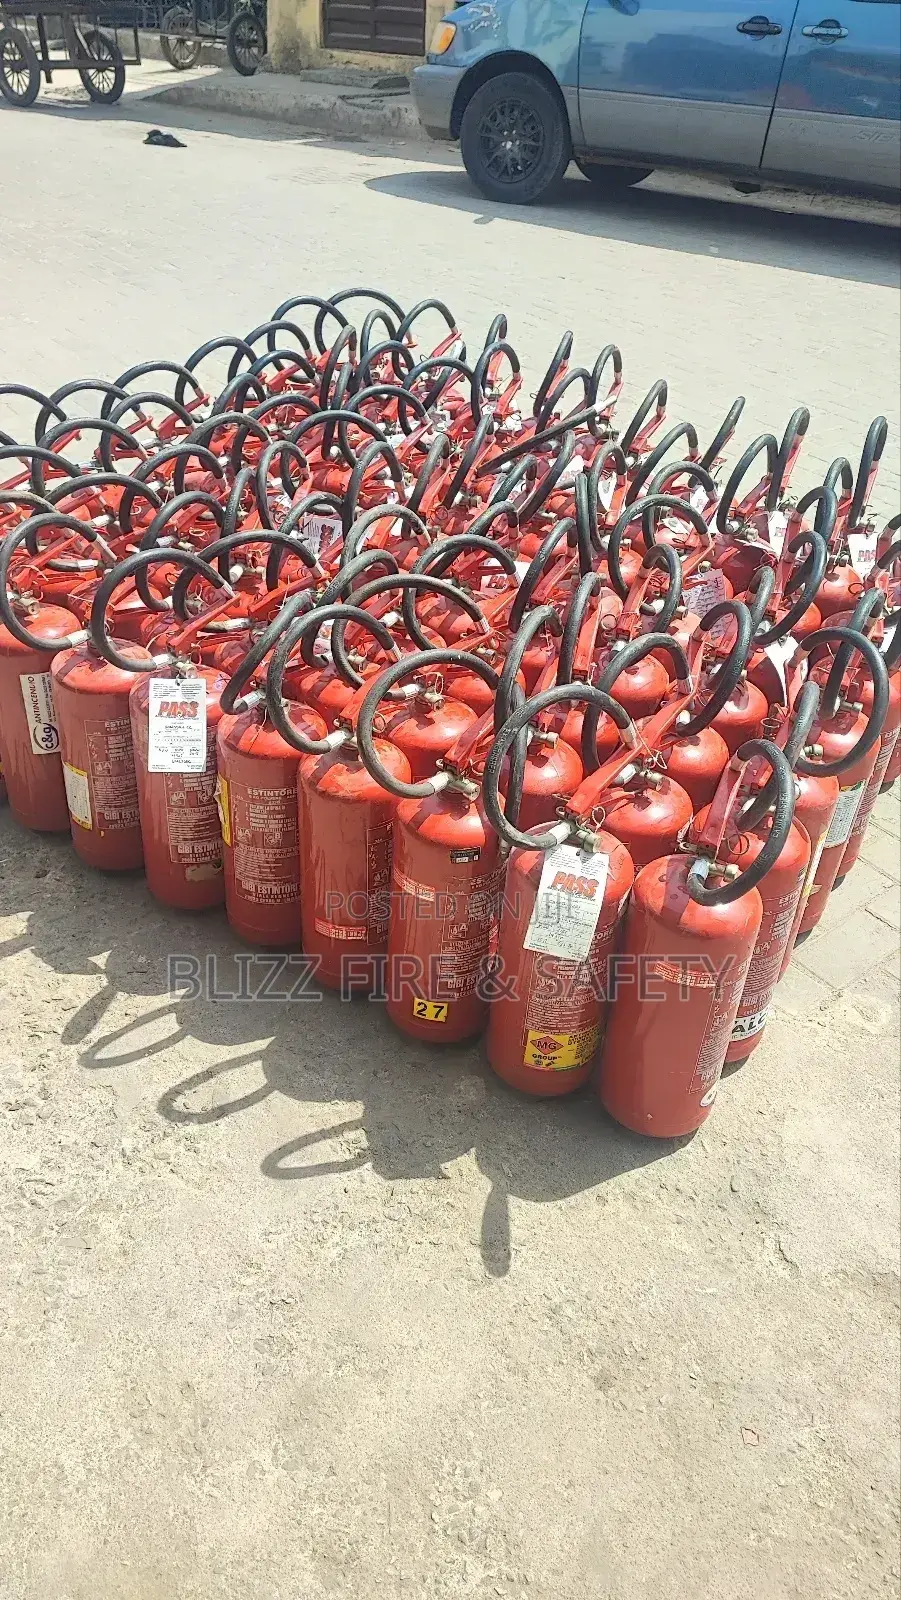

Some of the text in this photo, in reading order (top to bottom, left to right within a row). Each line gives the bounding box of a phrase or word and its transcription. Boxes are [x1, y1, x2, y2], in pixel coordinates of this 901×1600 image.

[157, 700, 199, 717] PASS
[551, 870, 600, 899] PASS
[416, 1001, 445, 1019] 27
[537, 1040, 557, 1050] MG
[532, 1053, 558, 1061] GROUP
